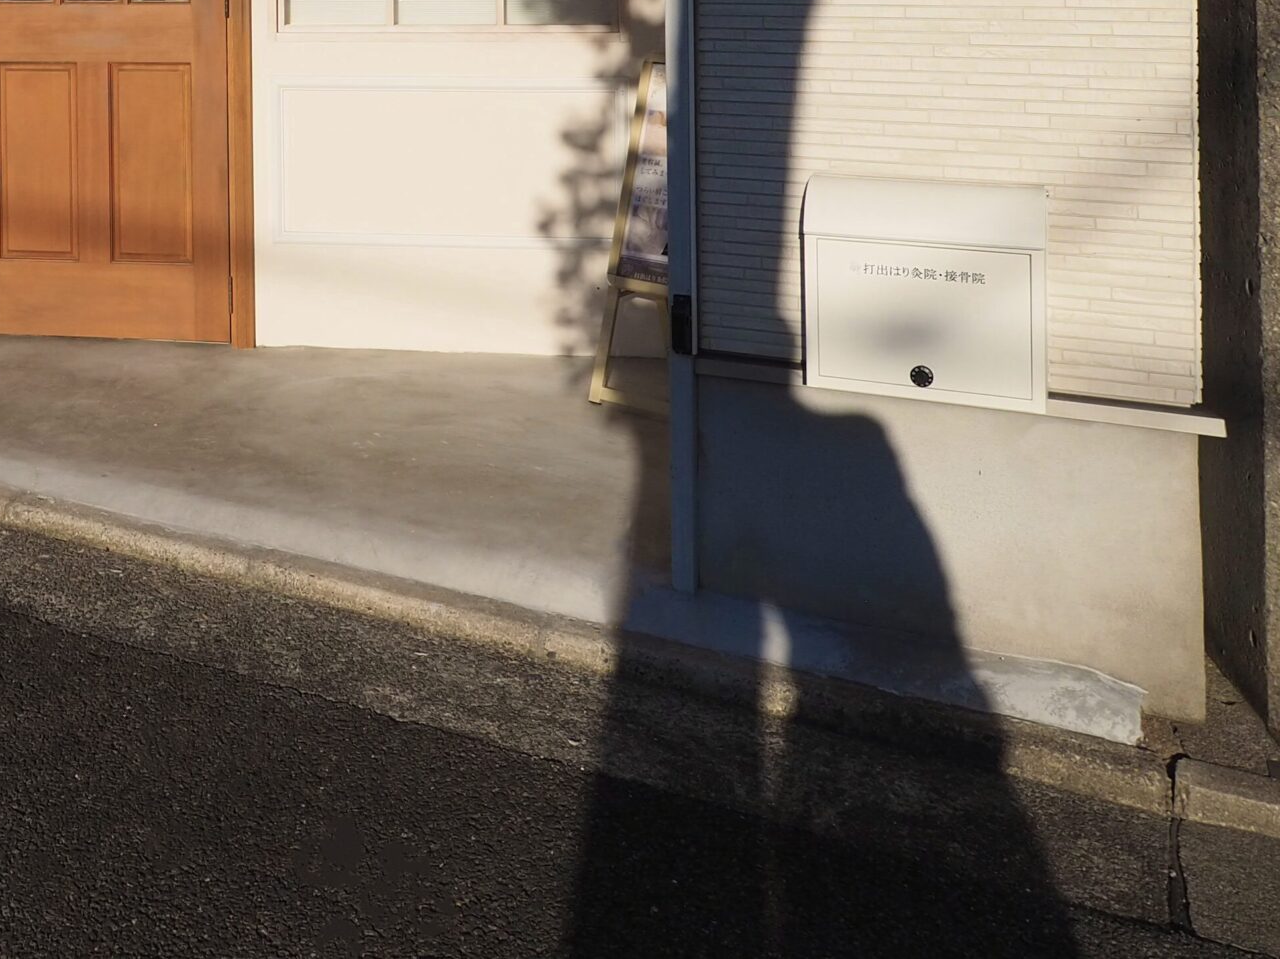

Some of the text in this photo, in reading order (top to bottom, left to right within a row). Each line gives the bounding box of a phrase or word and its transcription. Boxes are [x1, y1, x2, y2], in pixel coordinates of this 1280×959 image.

[863, 262, 986, 285] 打出はり灸院・接骨院
